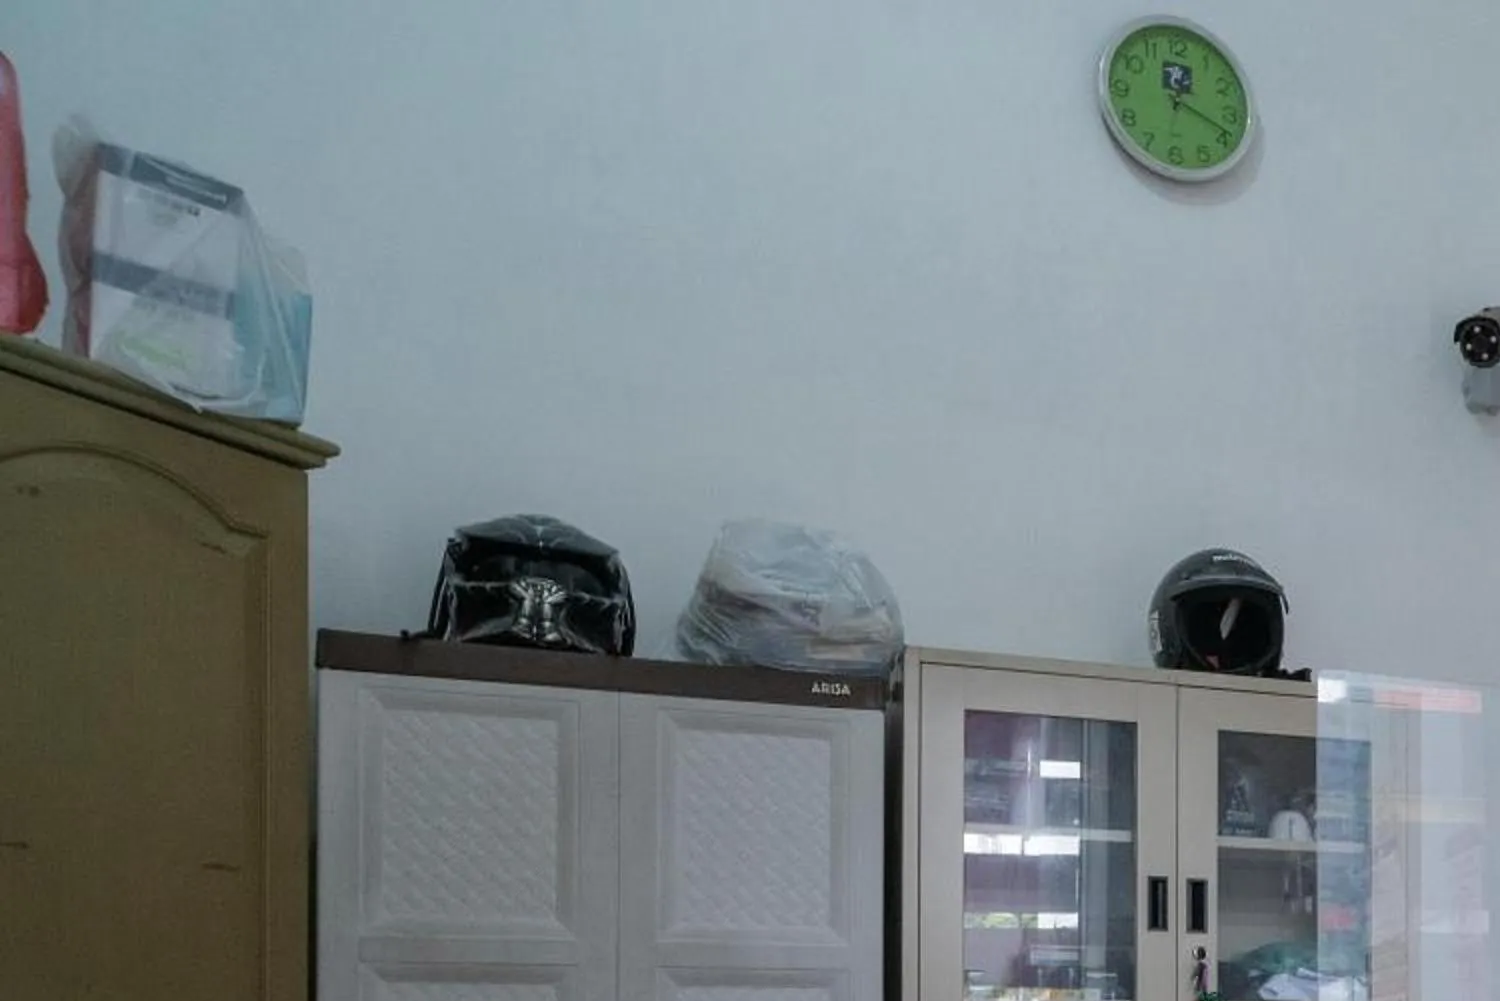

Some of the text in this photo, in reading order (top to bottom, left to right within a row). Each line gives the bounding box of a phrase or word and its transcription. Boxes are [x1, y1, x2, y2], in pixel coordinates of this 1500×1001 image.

[1144, 38, 1157, 60] 11
[1169, 38, 1188, 59] 12
[1124, 53, 1144, 75] 10
[1113, 79, 1129, 98] 9
[1216, 77, 1234, 97] 2
[1122, 108, 1136, 127] 8
[1222, 105, 1237, 125] 3
[1168, 146, 1184, 165] 6
[1197, 145, 1210, 163] 5
